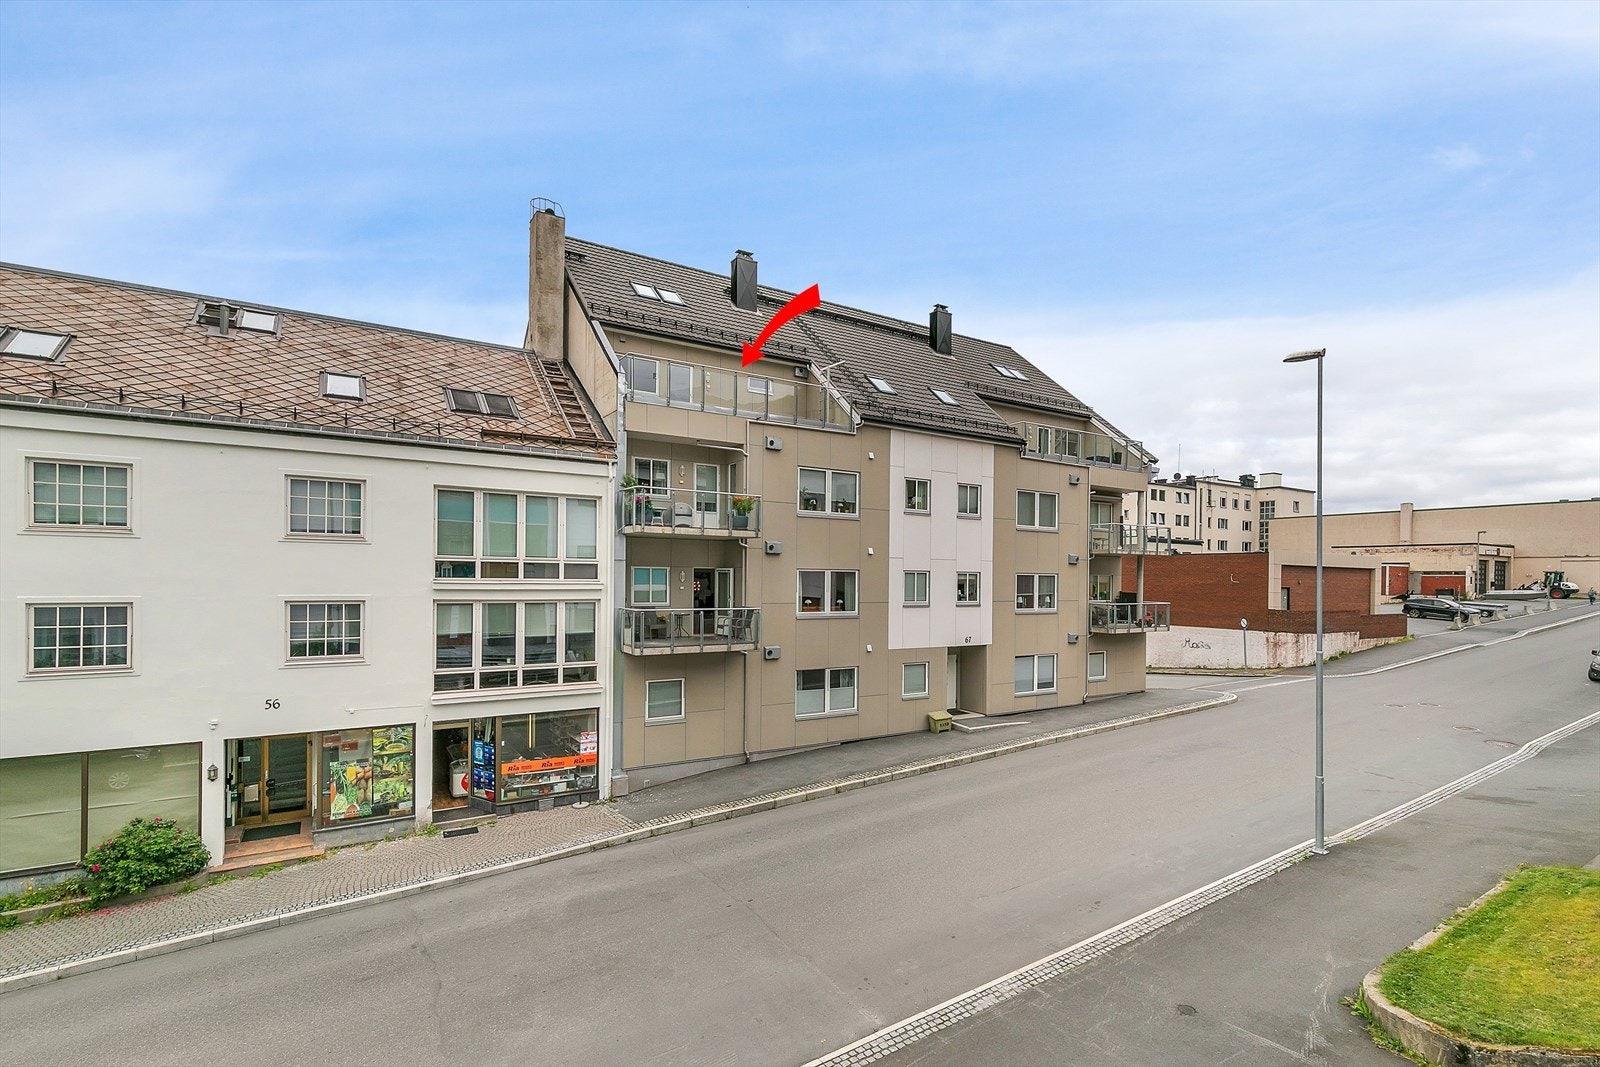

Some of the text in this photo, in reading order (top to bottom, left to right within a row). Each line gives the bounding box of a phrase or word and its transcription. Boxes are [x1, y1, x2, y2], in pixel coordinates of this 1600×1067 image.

[964, 636, 972, 644] 67
[264, 698, 281, 710] 56
[573, 757, 585, 765] Ria
[507, 764, 520, 772] Ria
